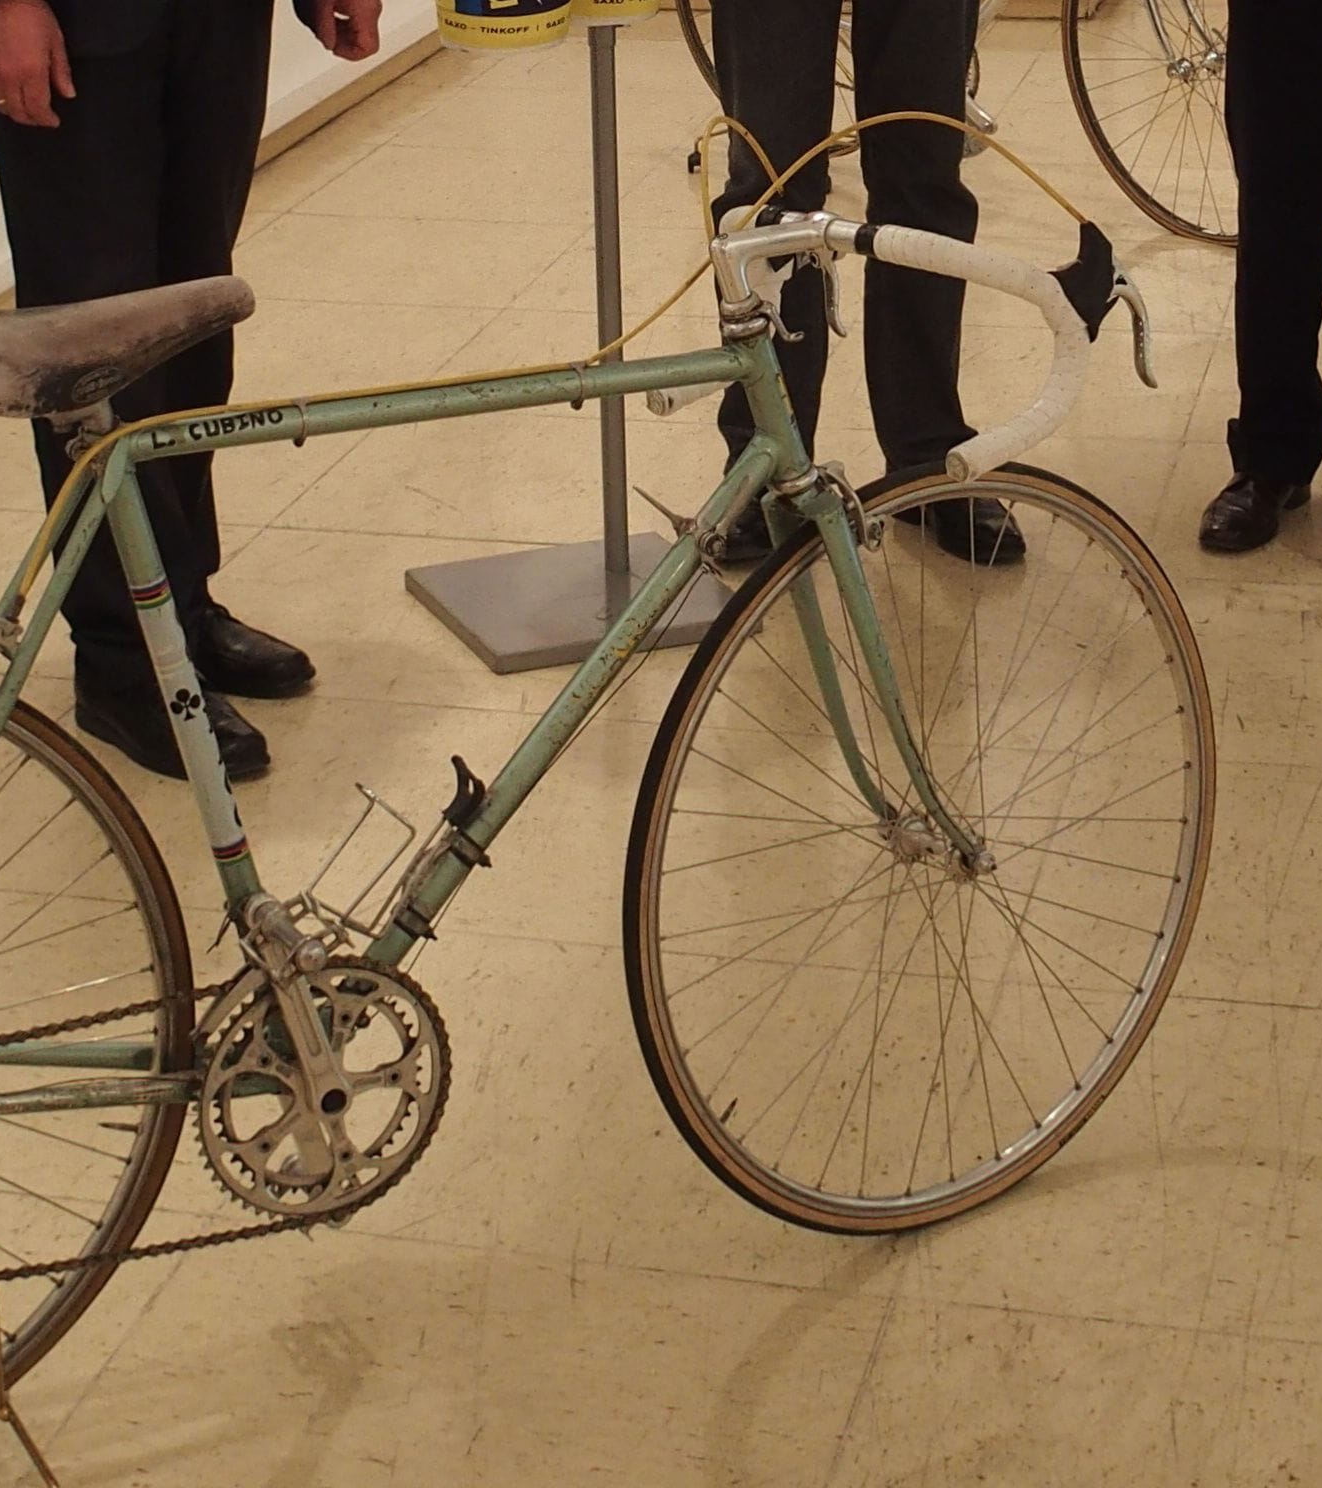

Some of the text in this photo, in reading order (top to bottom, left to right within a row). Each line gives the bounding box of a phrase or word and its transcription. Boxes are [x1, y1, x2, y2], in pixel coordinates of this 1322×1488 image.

[444, 18, 530, 34] SAXO TINKOFF
[152, 410, 284, 450] L. CUBINO
